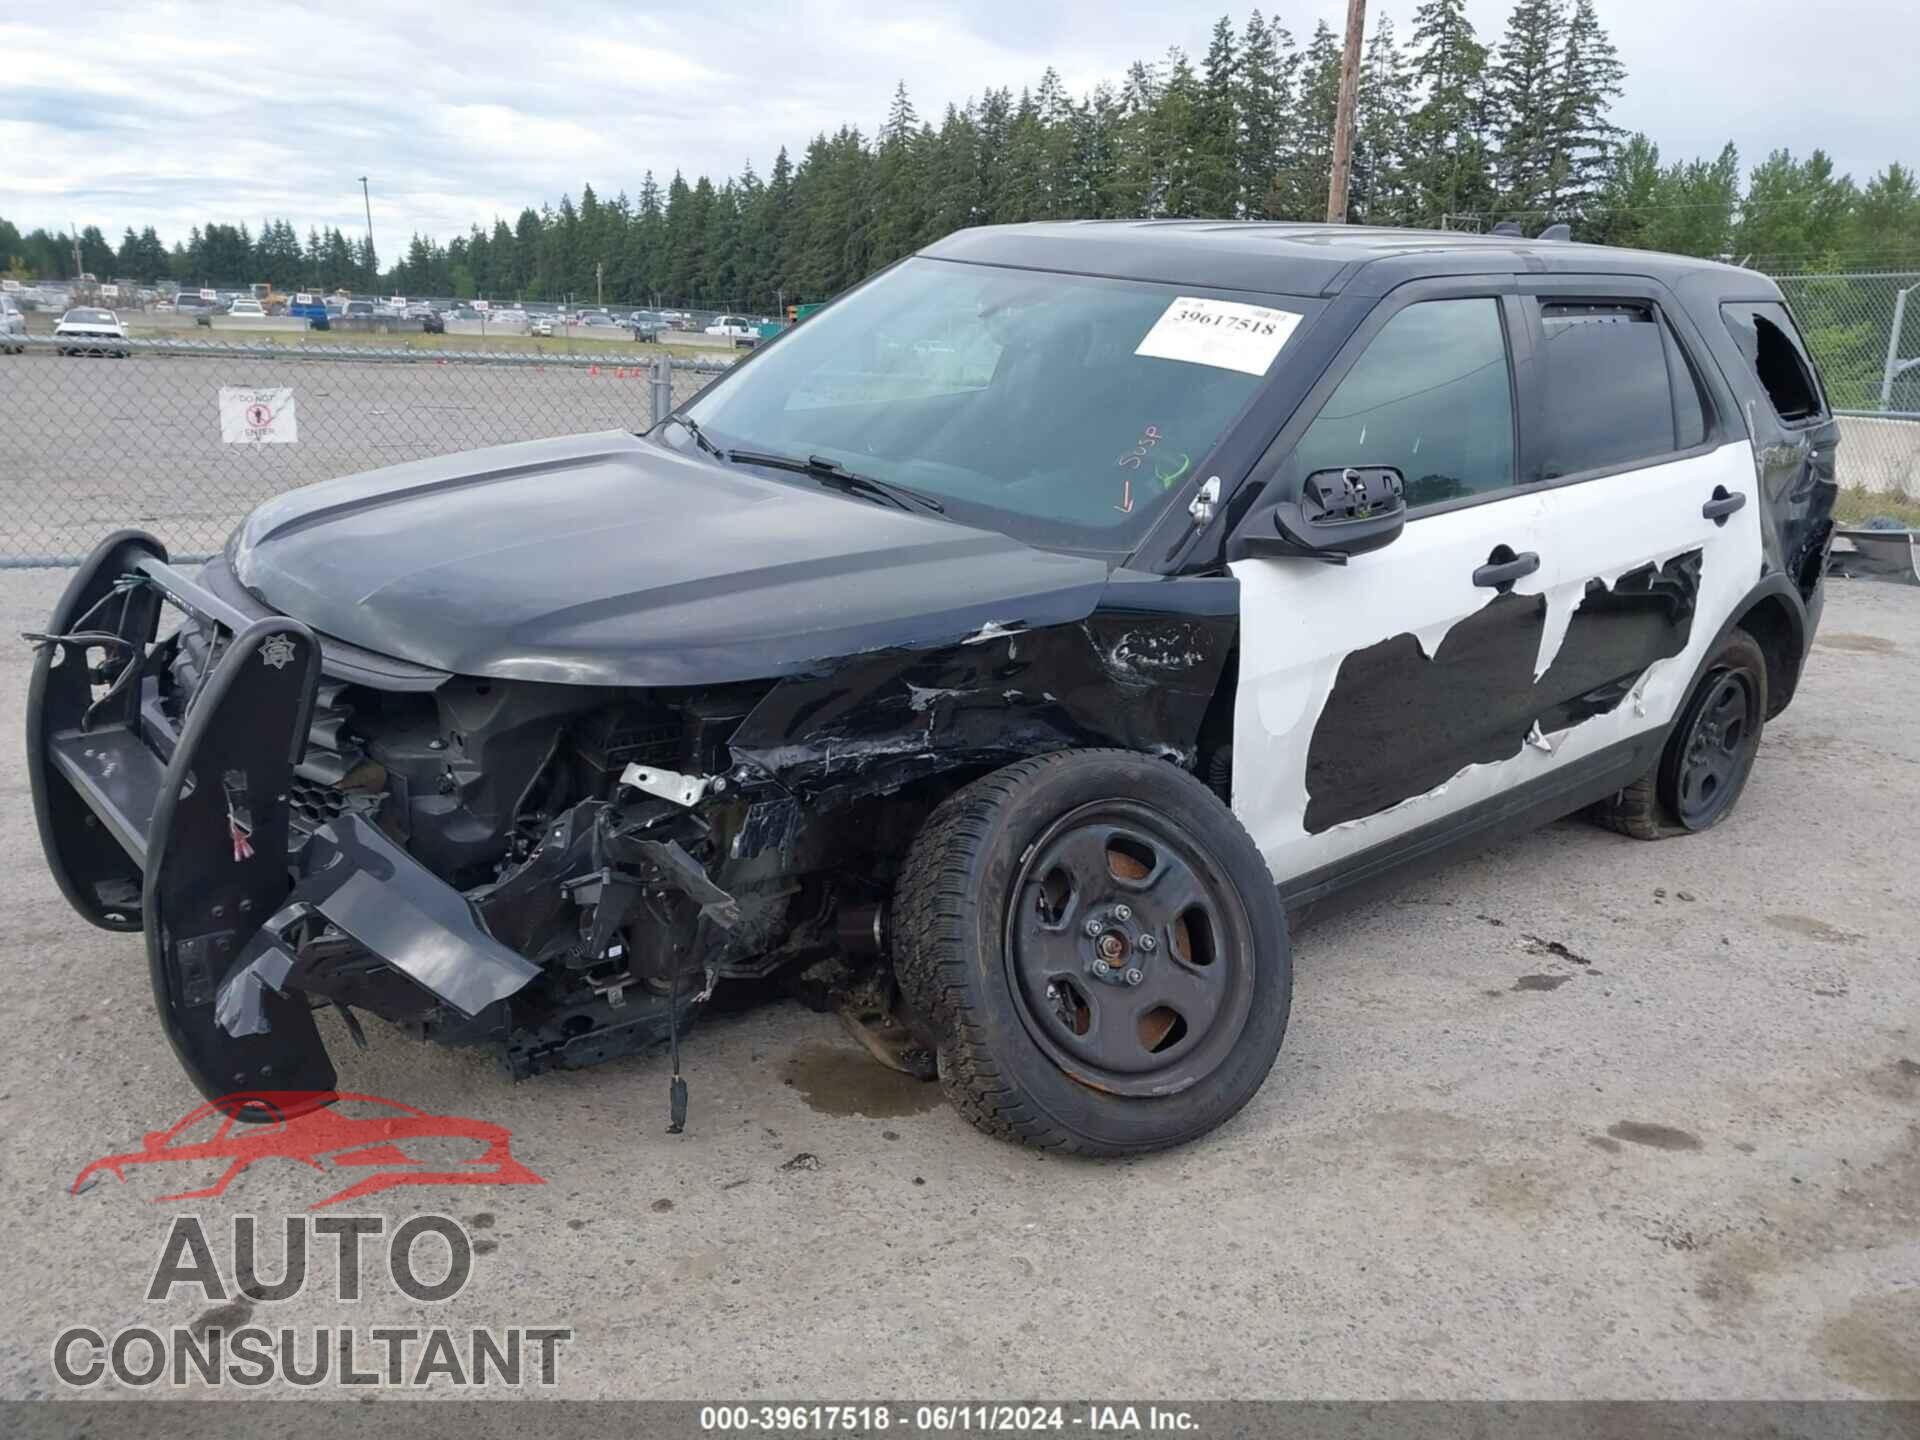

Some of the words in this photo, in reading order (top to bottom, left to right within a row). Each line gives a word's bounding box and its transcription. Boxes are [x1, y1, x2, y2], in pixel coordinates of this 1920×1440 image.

[1173, 309, 1277, 336] 39617518
[239, 393, 254, 403] DO
[255, 393, 275, 403] NOT
[244, 427, 275, 437] ENTER
